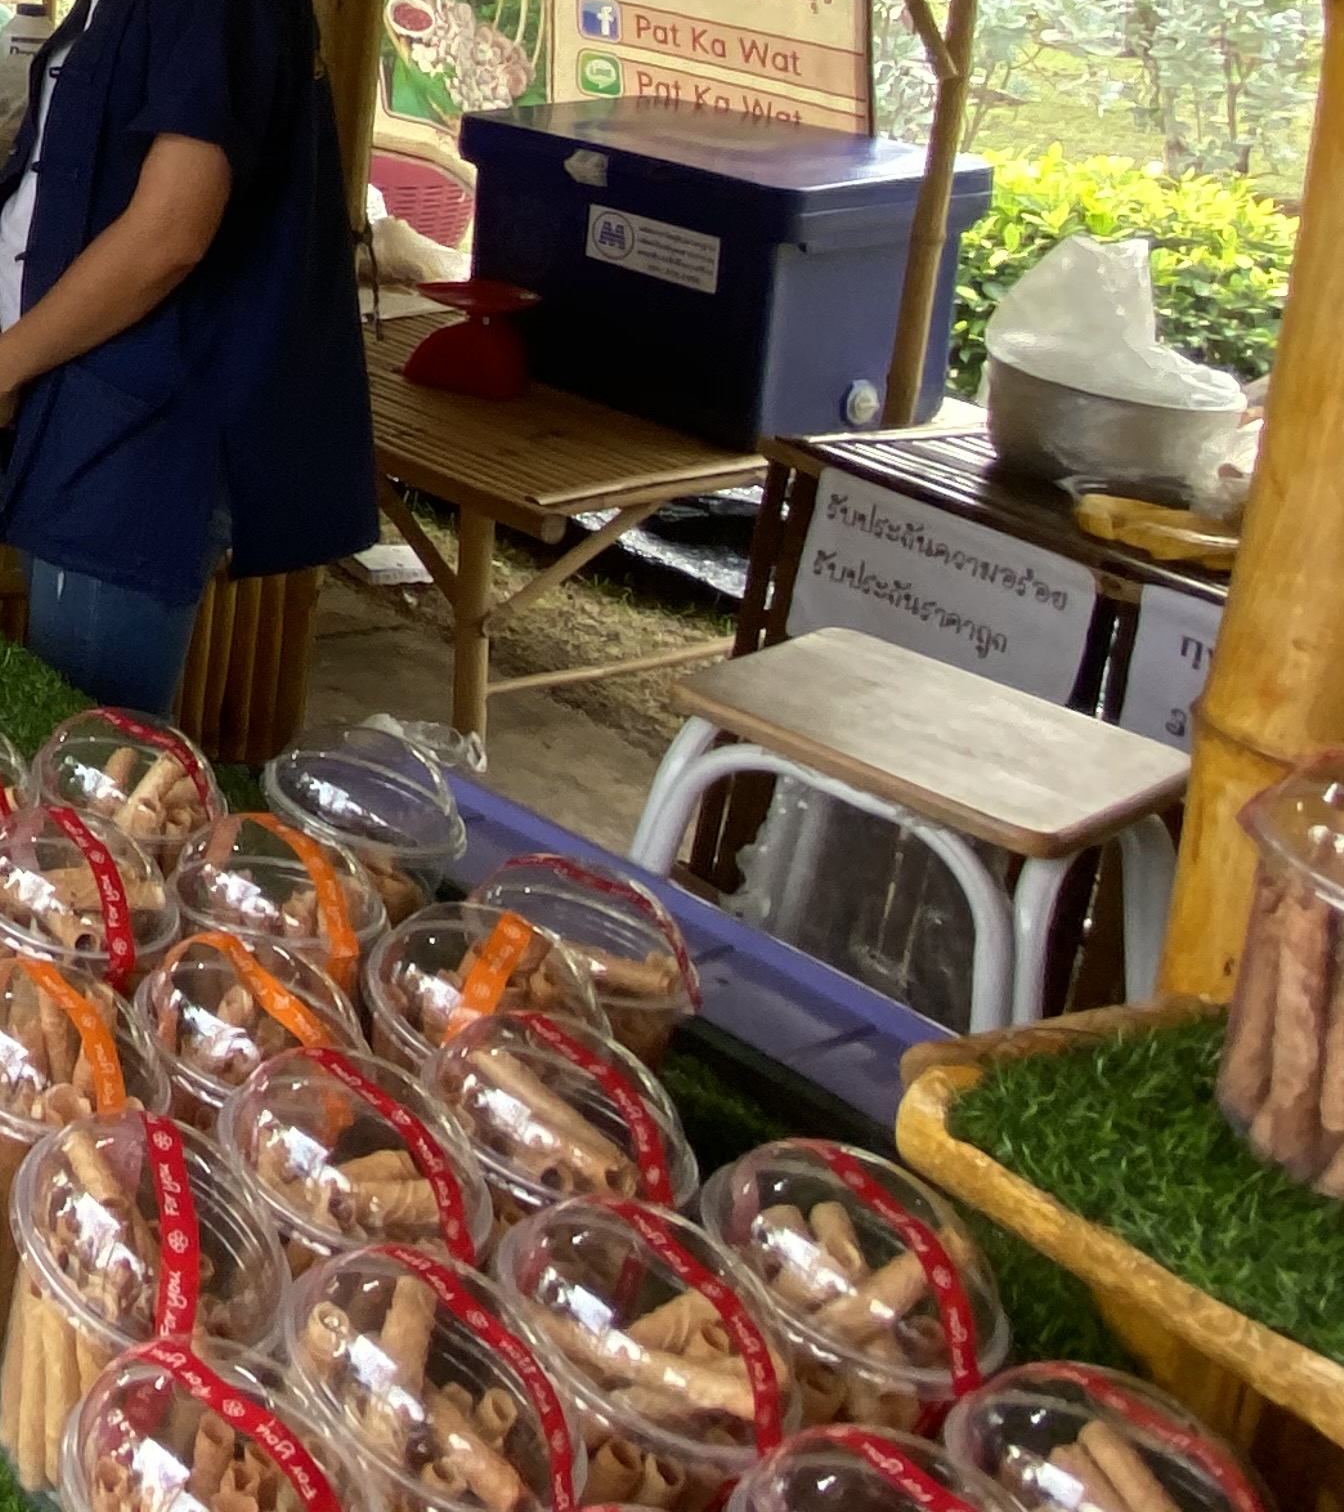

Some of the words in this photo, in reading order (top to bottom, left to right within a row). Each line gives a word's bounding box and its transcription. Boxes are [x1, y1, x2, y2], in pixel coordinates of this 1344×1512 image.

[635, 14, 681, 48] Pat
[690, 27, 727, 59] Ka
[739, 37, 803, 77] Wat
